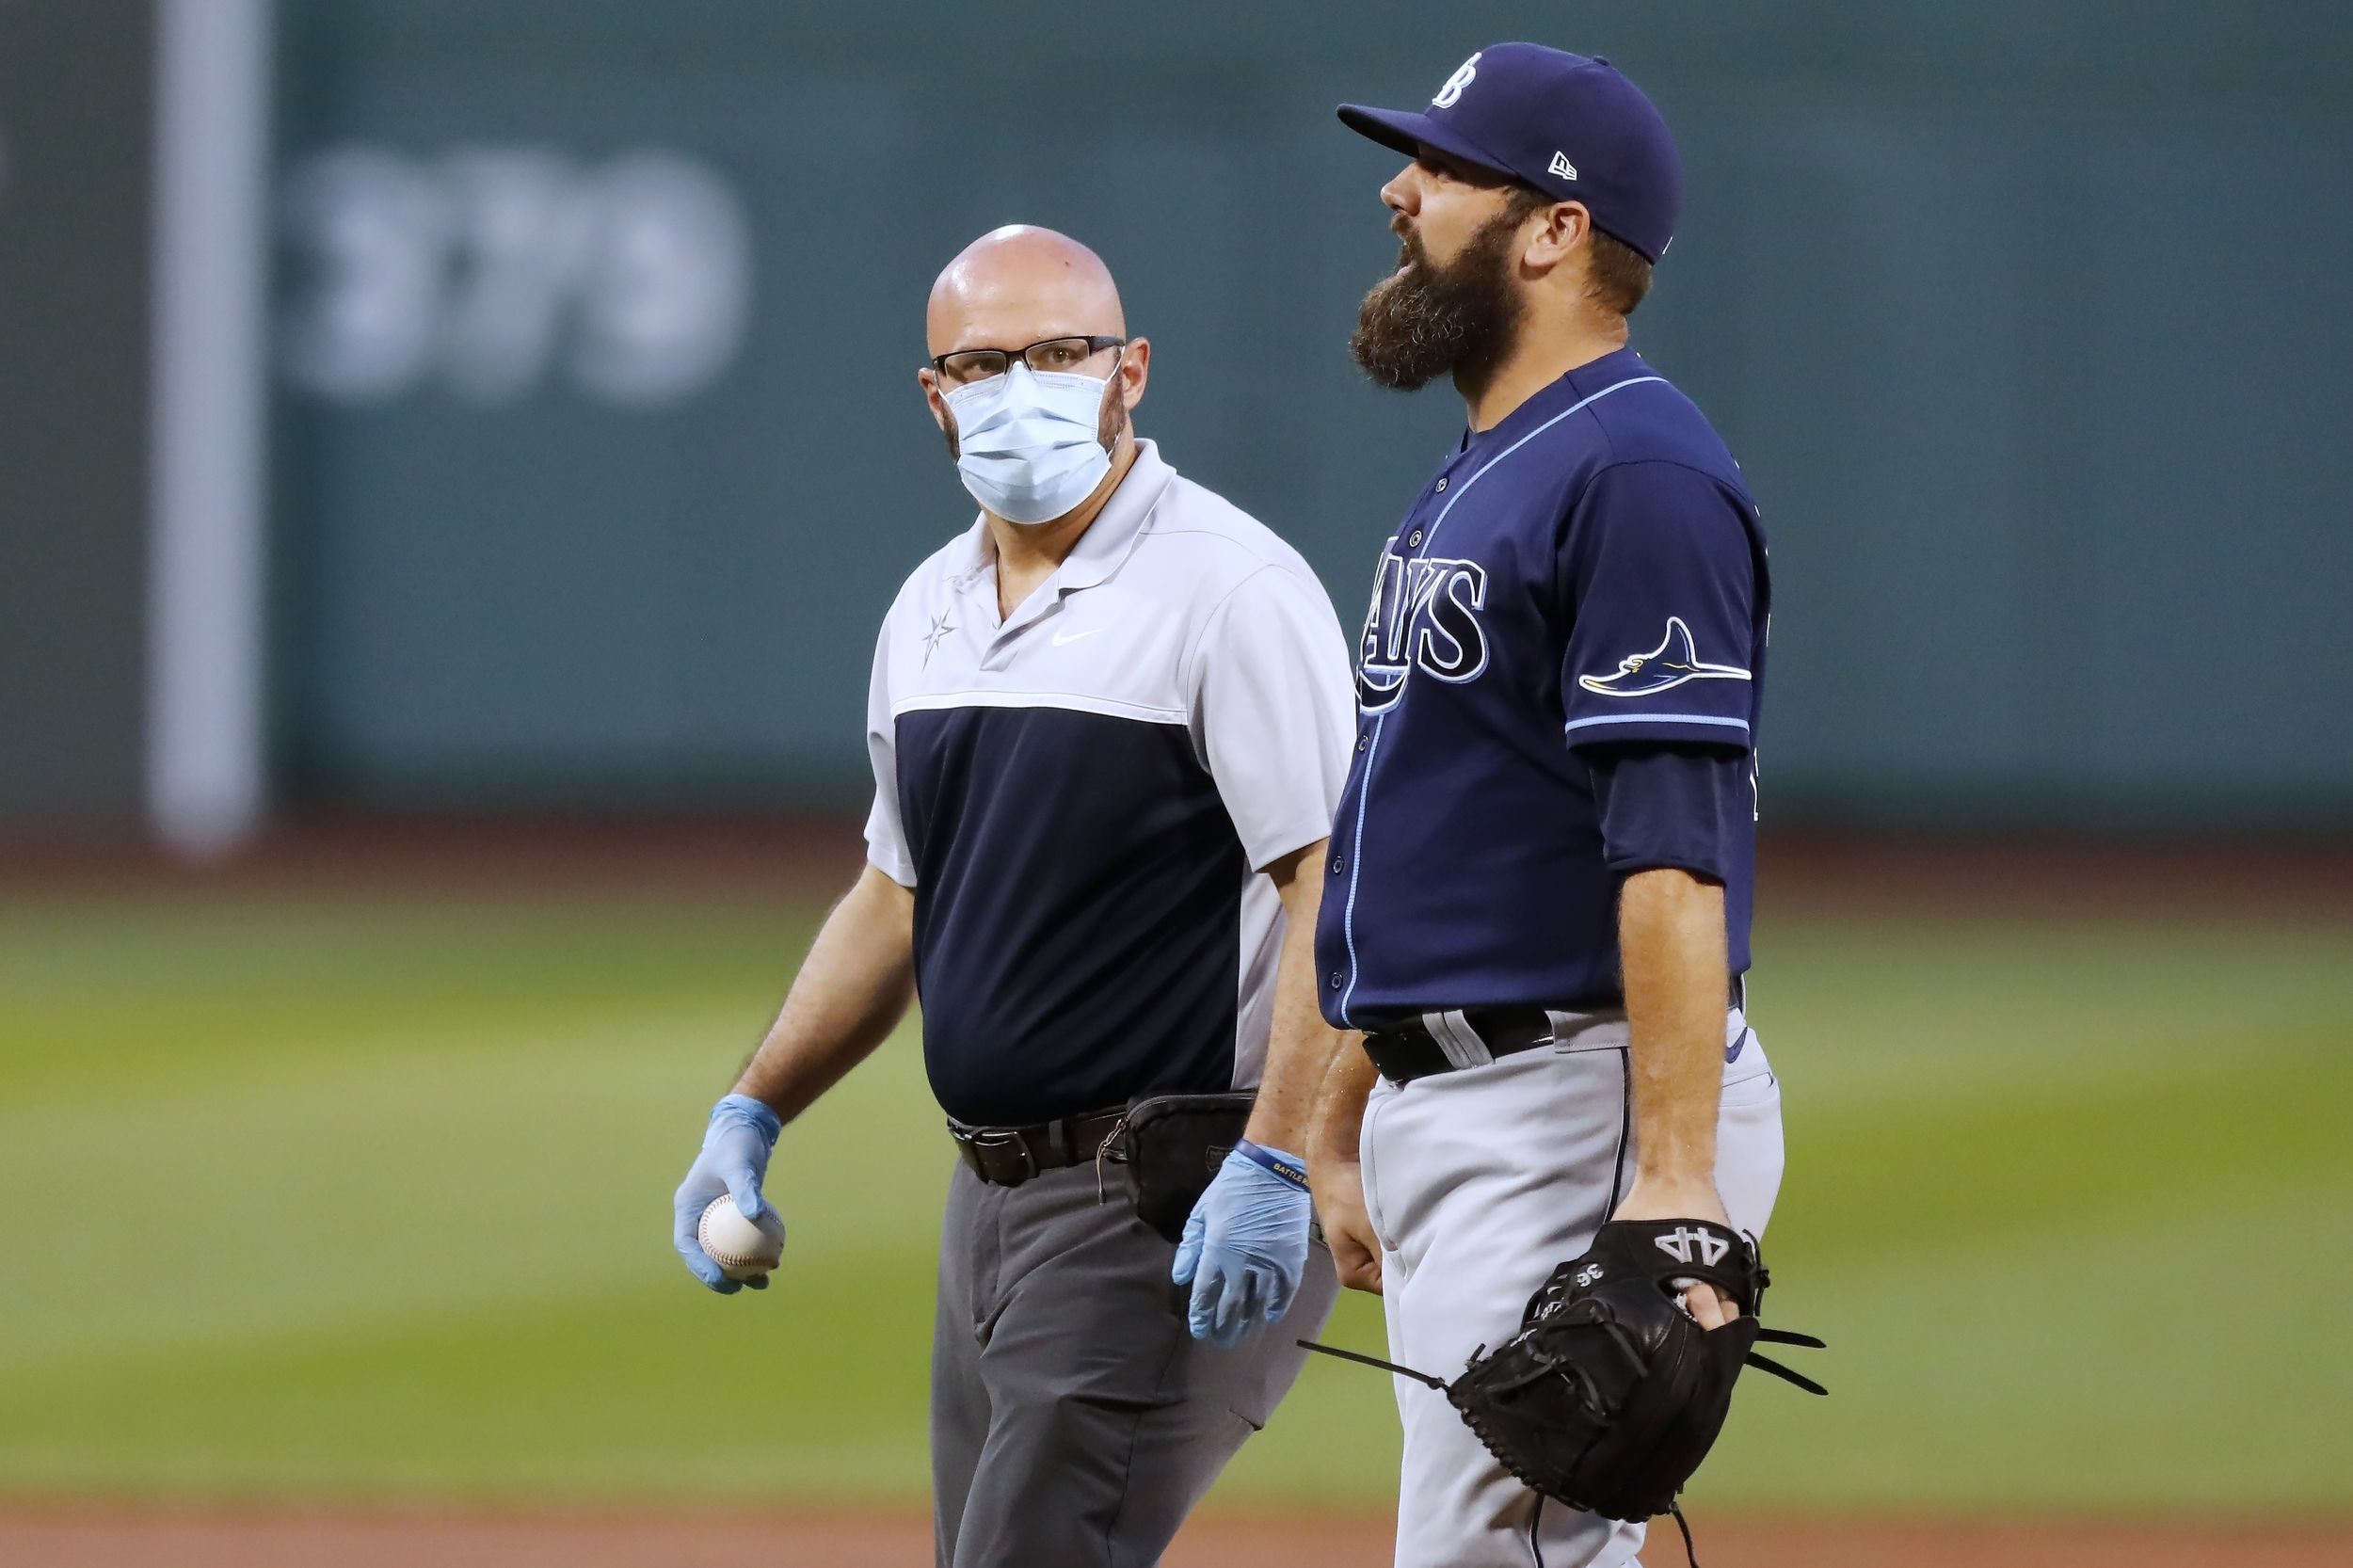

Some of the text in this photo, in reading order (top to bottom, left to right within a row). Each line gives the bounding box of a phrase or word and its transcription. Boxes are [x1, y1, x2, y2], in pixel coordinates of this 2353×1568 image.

[280, 141, 753, 408] 379
[1273, 1162, 1303, 1182] BATTLE
[1654, 1226, 1730, 1268] 44
